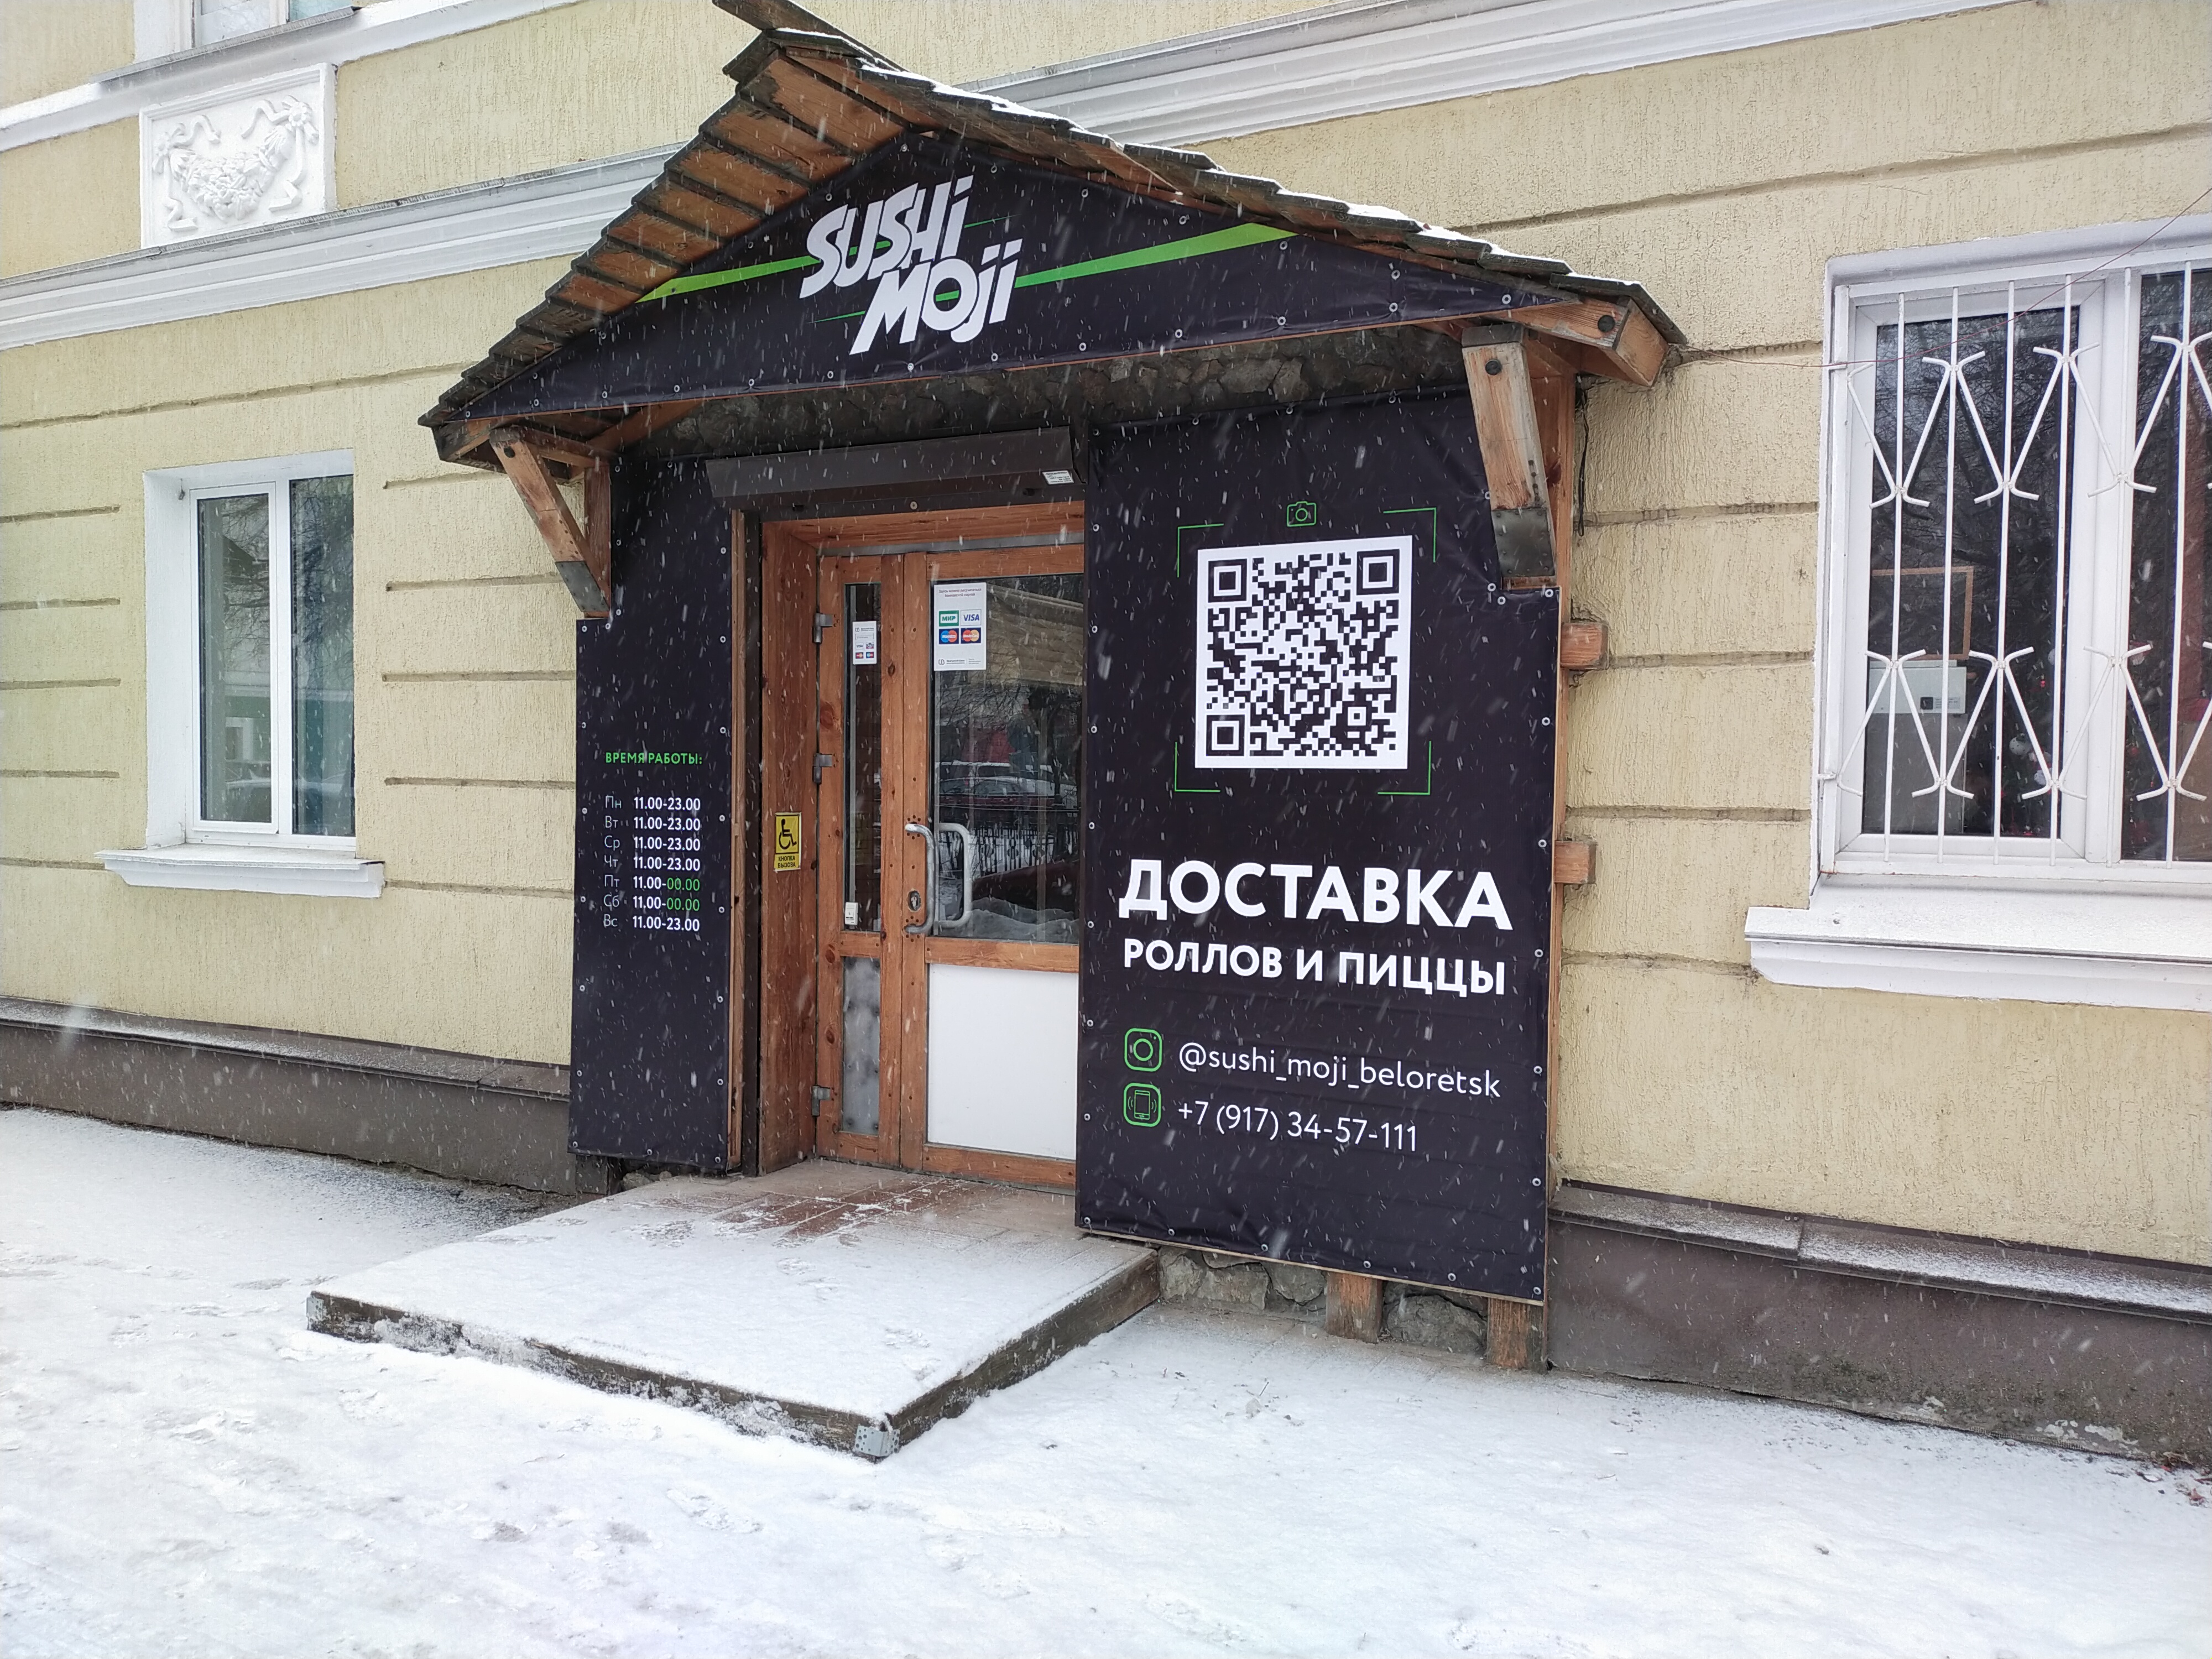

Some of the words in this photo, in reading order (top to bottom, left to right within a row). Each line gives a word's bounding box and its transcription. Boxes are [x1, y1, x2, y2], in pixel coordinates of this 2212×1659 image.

[606, 753, 645, 763] ВРЕМЯ
[648, 753, 702, 764] РАБОТЫ:
[606, 796, 622, 808] Пн
[634, 797, 701, 811] 11.00-23.00
[606, 816, 619, 828] Вт
[634, 817, 701, 831] 11.00-23.00
[604, 836, 620, 851] Ср
[634, 836, 701, 851] 11.00-23.00
[604, 855, 618, 868] Чт
[634, 857, 701, 871] 11.00-23.00
[605, 875, 620, 888] Пт
[633, 876, 700, 891] 11.00-00.00
[1119, 859, 1513, 930] ДОСТАВКА
[604, 895, 619, 910] Сб
[633, 895, 700, 911] 11.00-00.00
[604, 914, 618, 927] Вс
[633, 916, 700, 931] 11.00-23.00
[1124, 938, 1282, 978] РОЛЛОВ
[1296, 948, 1323, 982] И
[1338, 951, 1505, 998] ПИЦЦЫ
[1179, 1042, 1501, 1098] @sushi_moji_beloretsk
[1178, 1100, 1209, 1125] +7
[1217, 1104, 1279, 1140] (917)
[1287, 1111, 1416, 1151] 34-57-111
